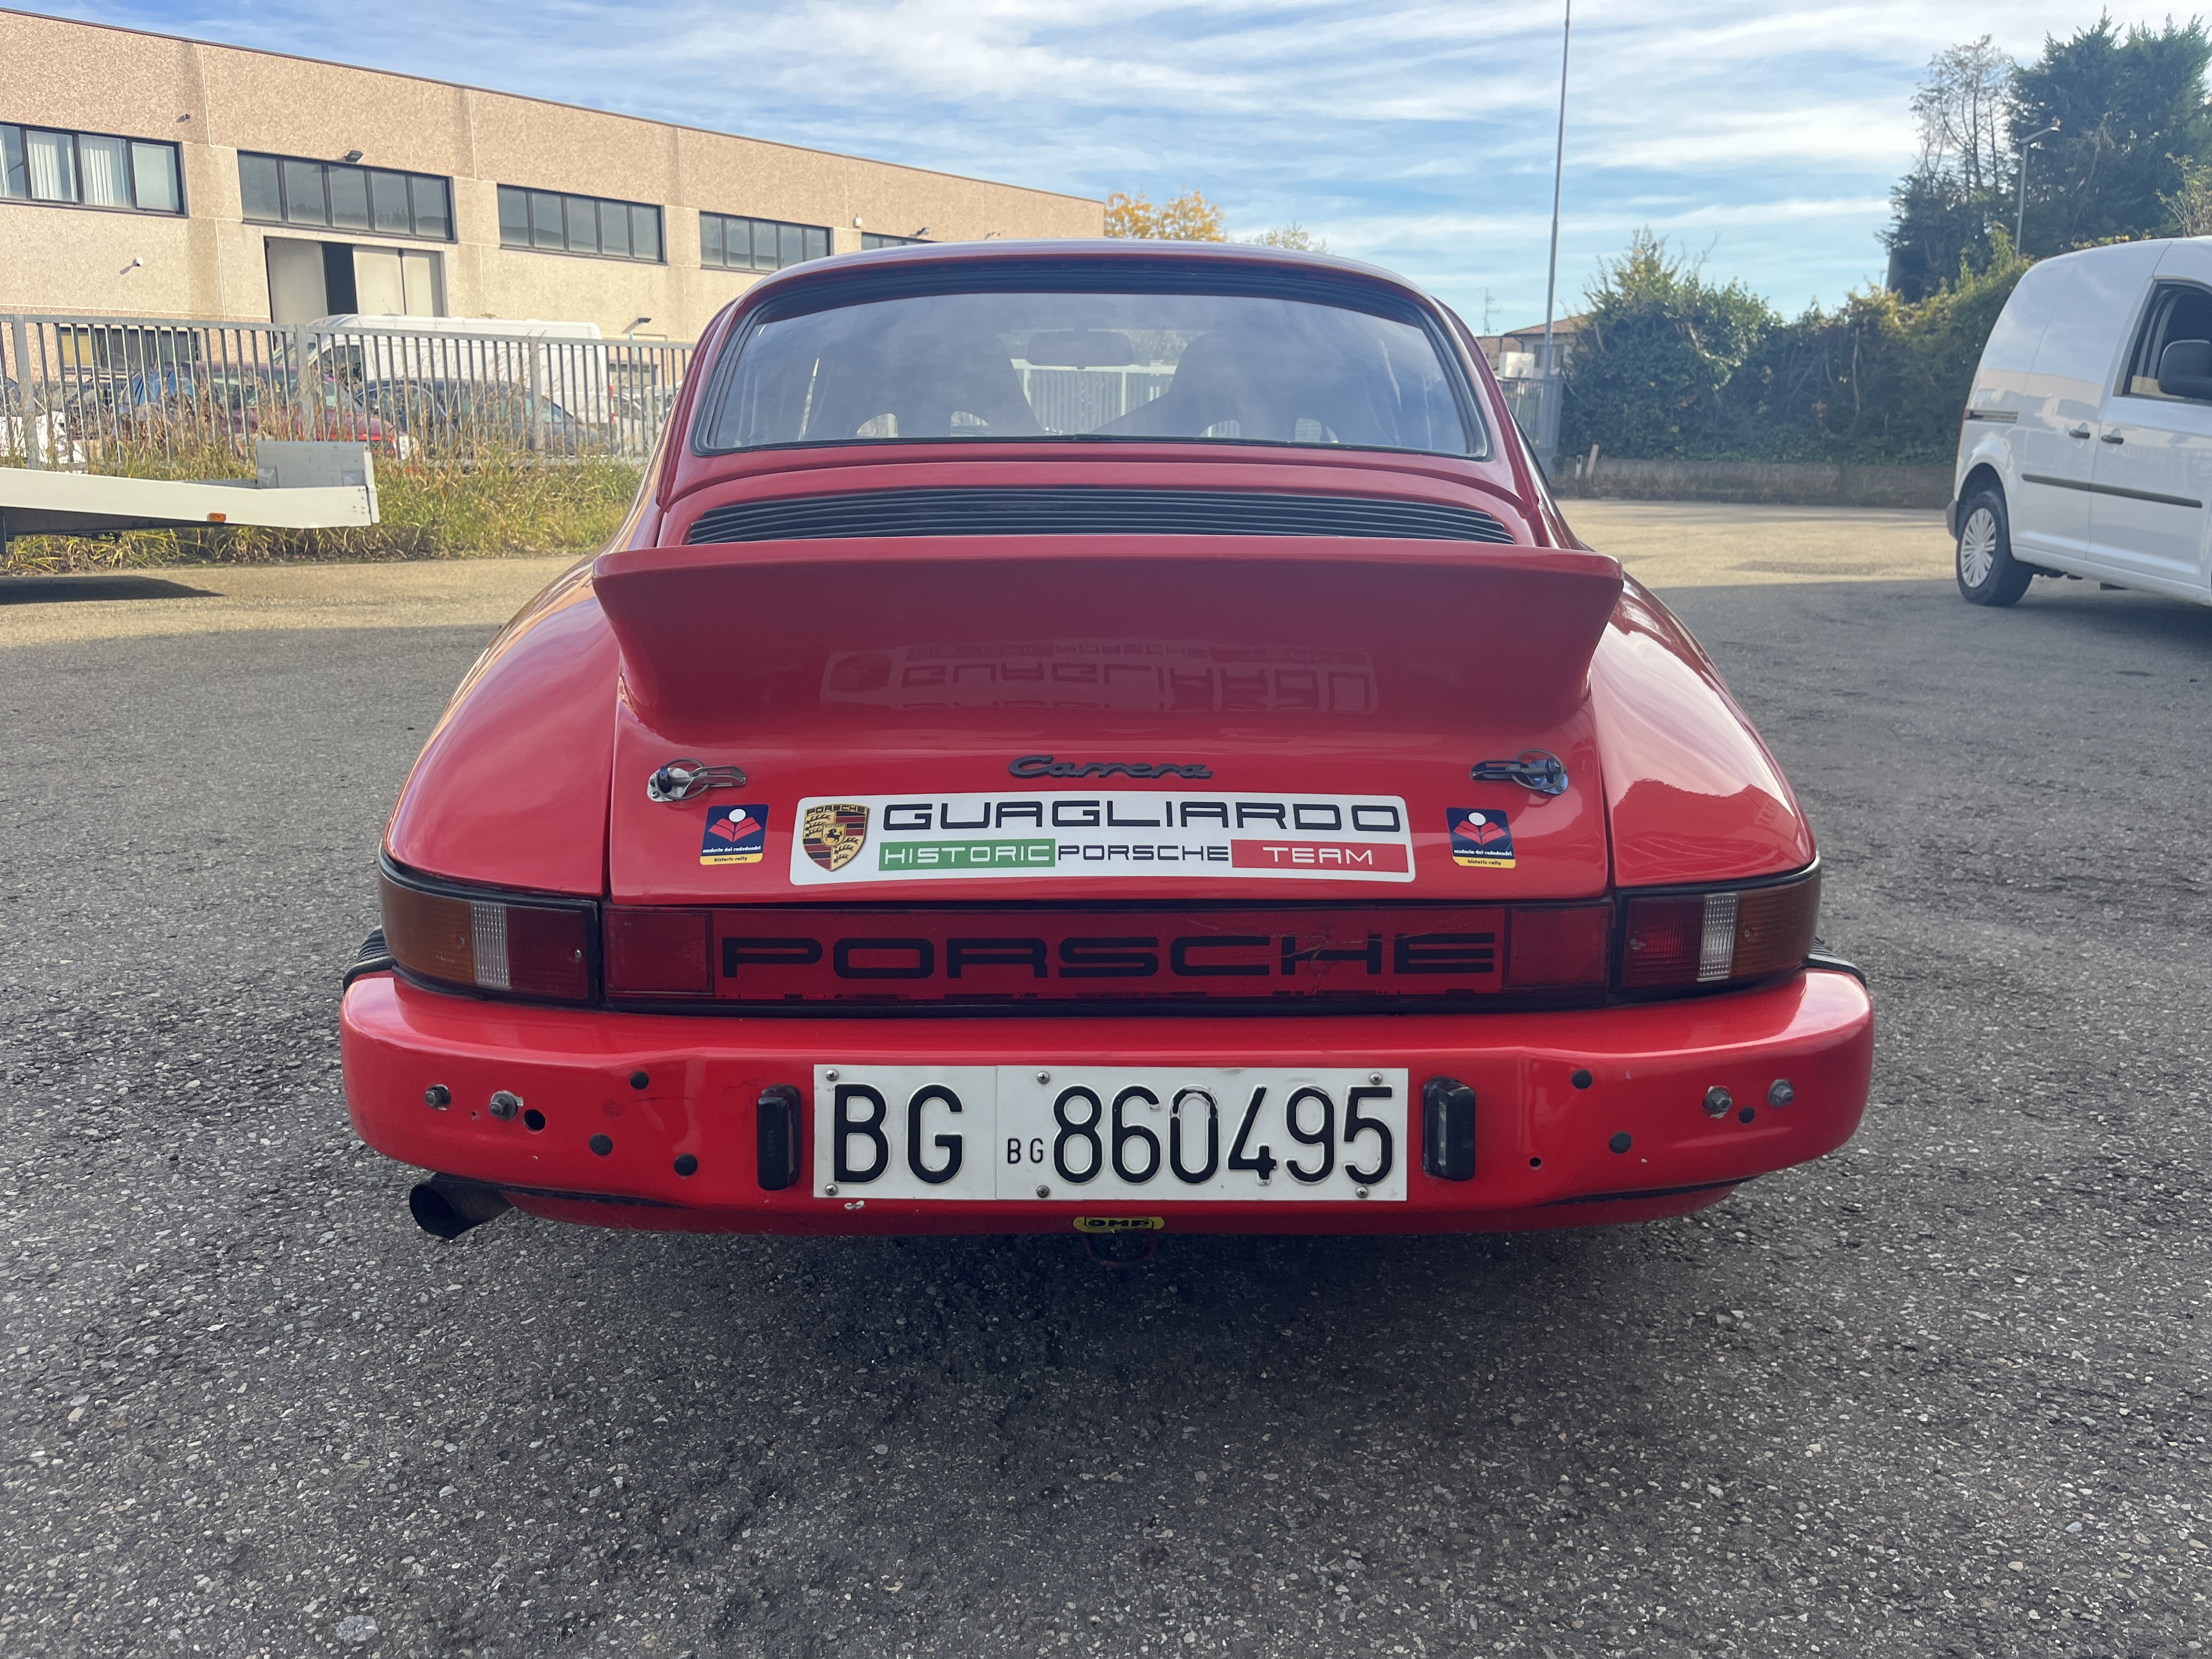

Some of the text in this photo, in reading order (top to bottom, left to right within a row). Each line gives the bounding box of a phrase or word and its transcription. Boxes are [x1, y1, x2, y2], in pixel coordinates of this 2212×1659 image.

[1009, 754, 1214, 779] Carrera
[807, 804, 865, 816] PORSCHE
[883, 800, 1401, 832] GUAGLIARDO
[884, 845, 1373, 865] HISTORIC PORSCHE TEAM
[721, 933, 1495, 979] PORSCHE
[834, 1084, 1393, 1184] BG BG 860495
